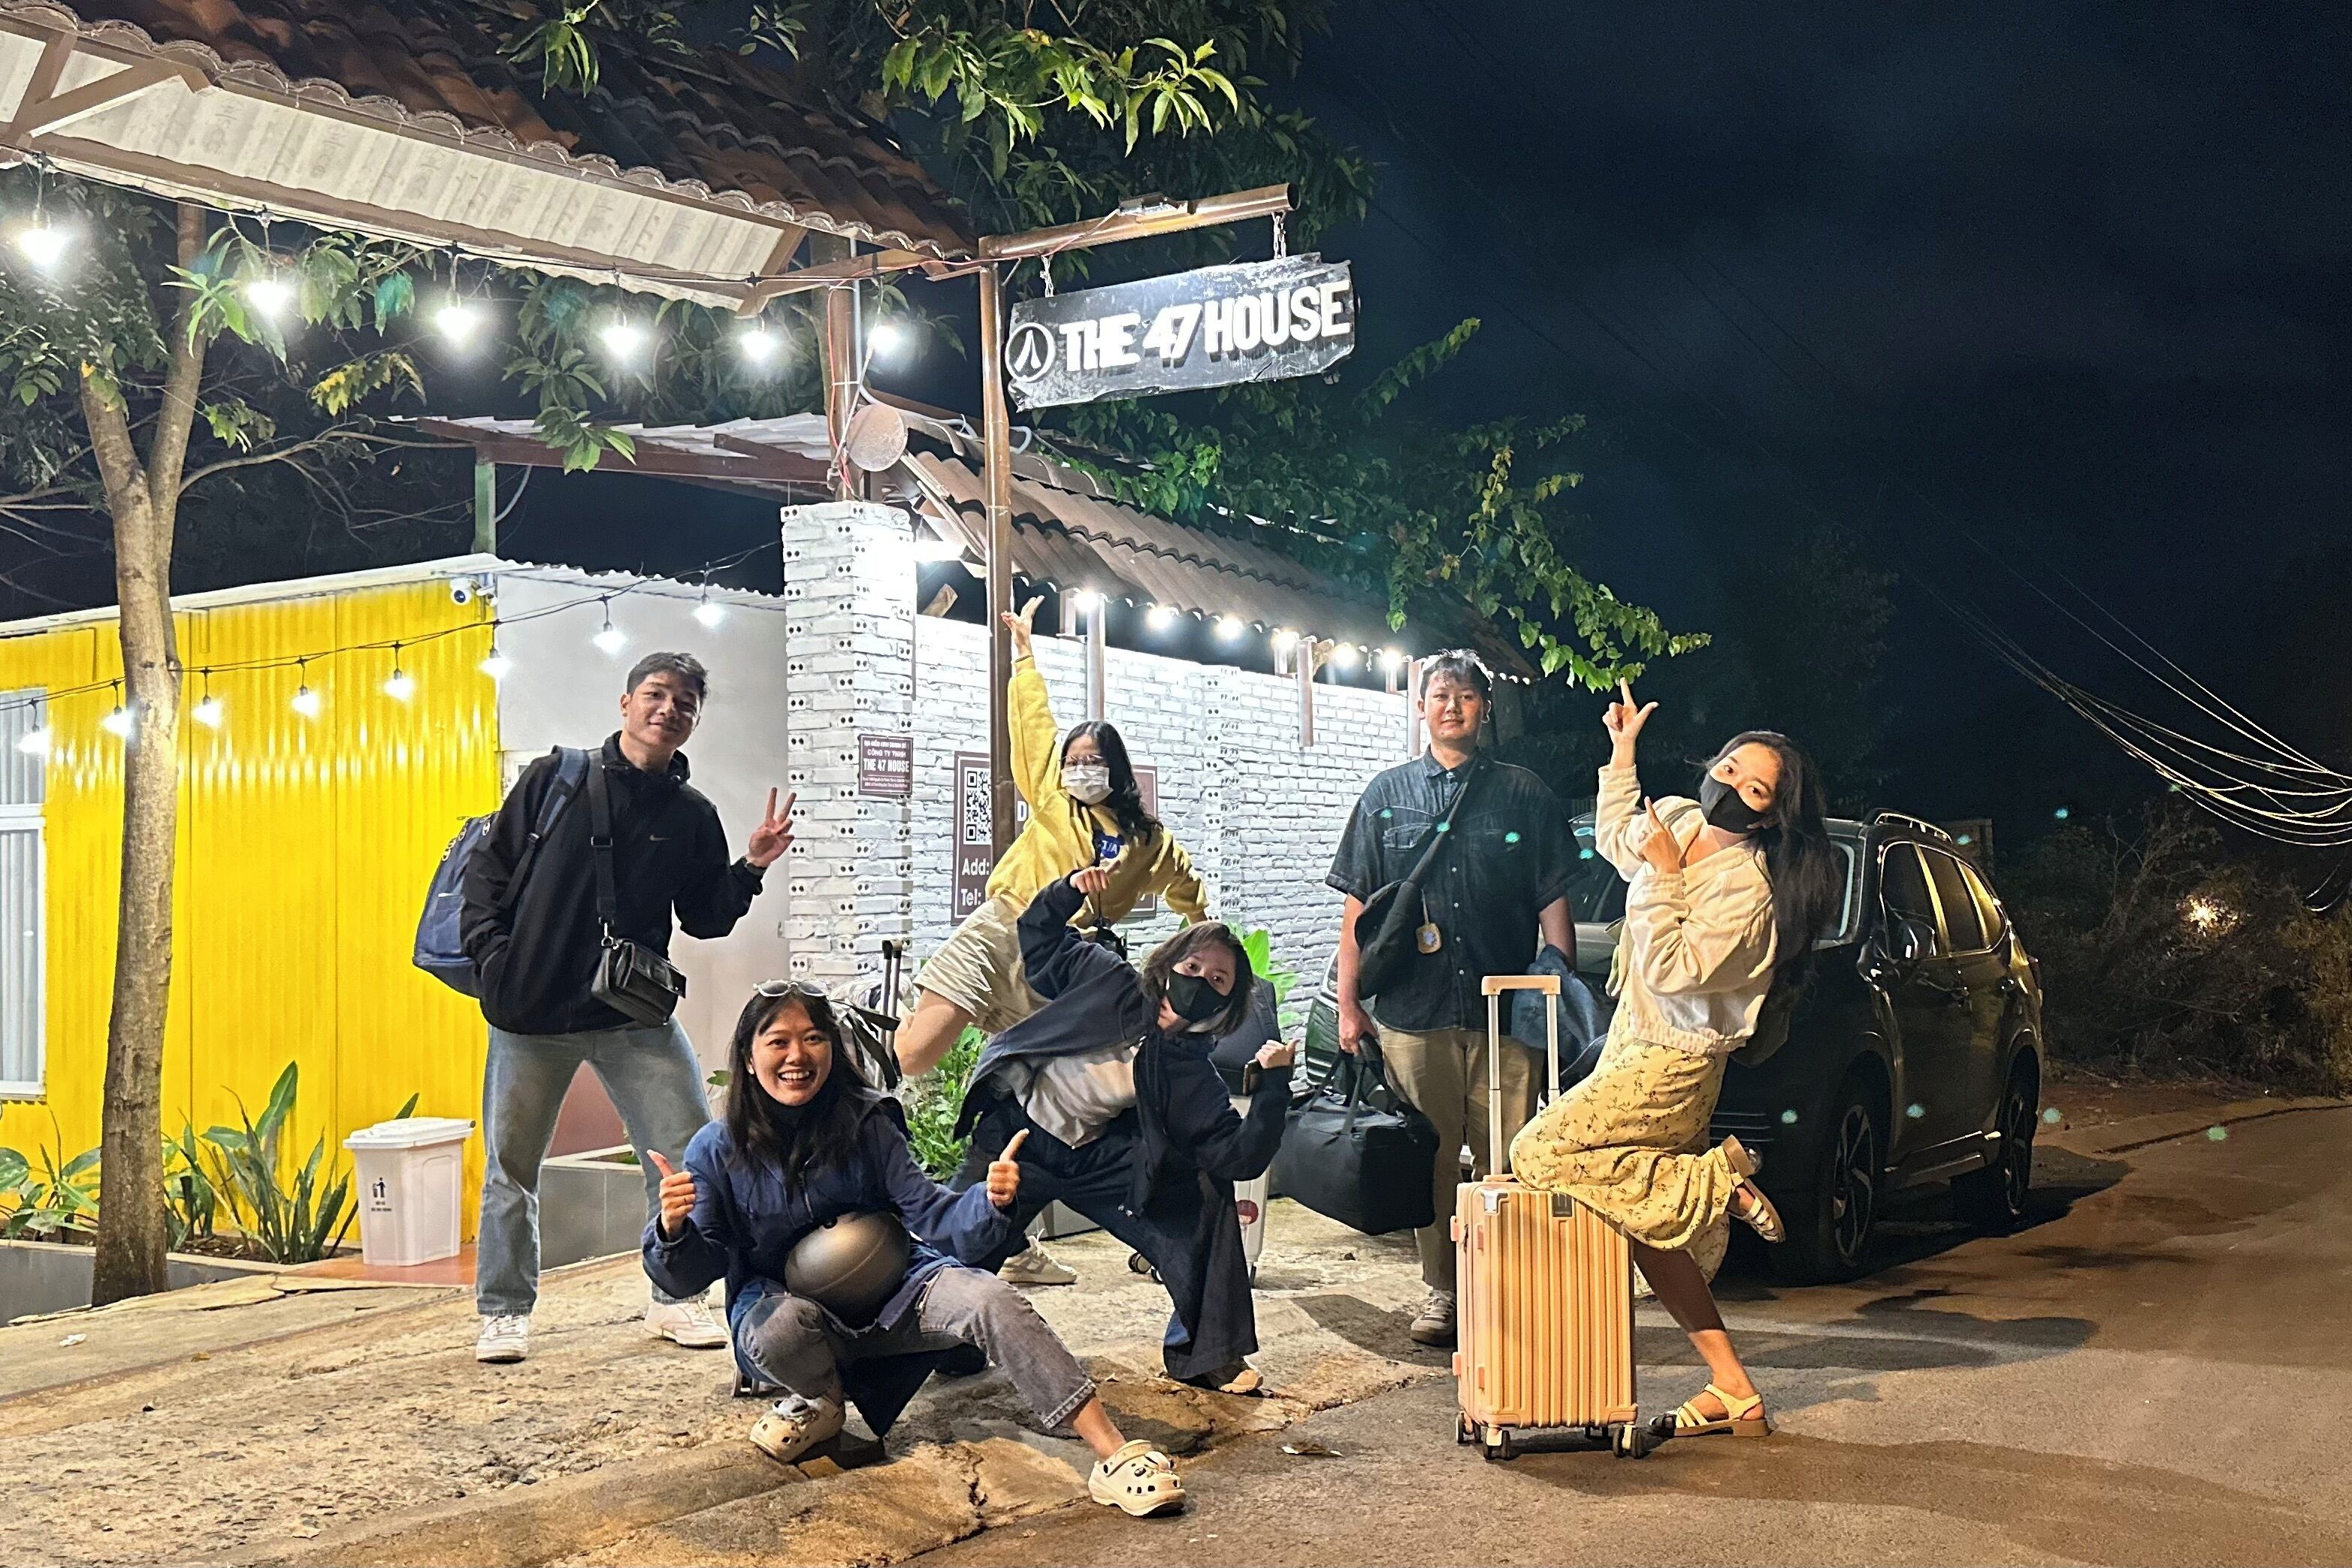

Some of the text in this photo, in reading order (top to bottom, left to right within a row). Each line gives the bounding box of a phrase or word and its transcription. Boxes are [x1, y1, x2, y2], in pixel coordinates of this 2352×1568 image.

[1059, 280, 1350, 371] THE 47 HOUSE
[863, 758, 910, 772] THE 47 HOUSE
[962, 858, 990, 876] Add:
[961, 888, 981, 906] Tel:
